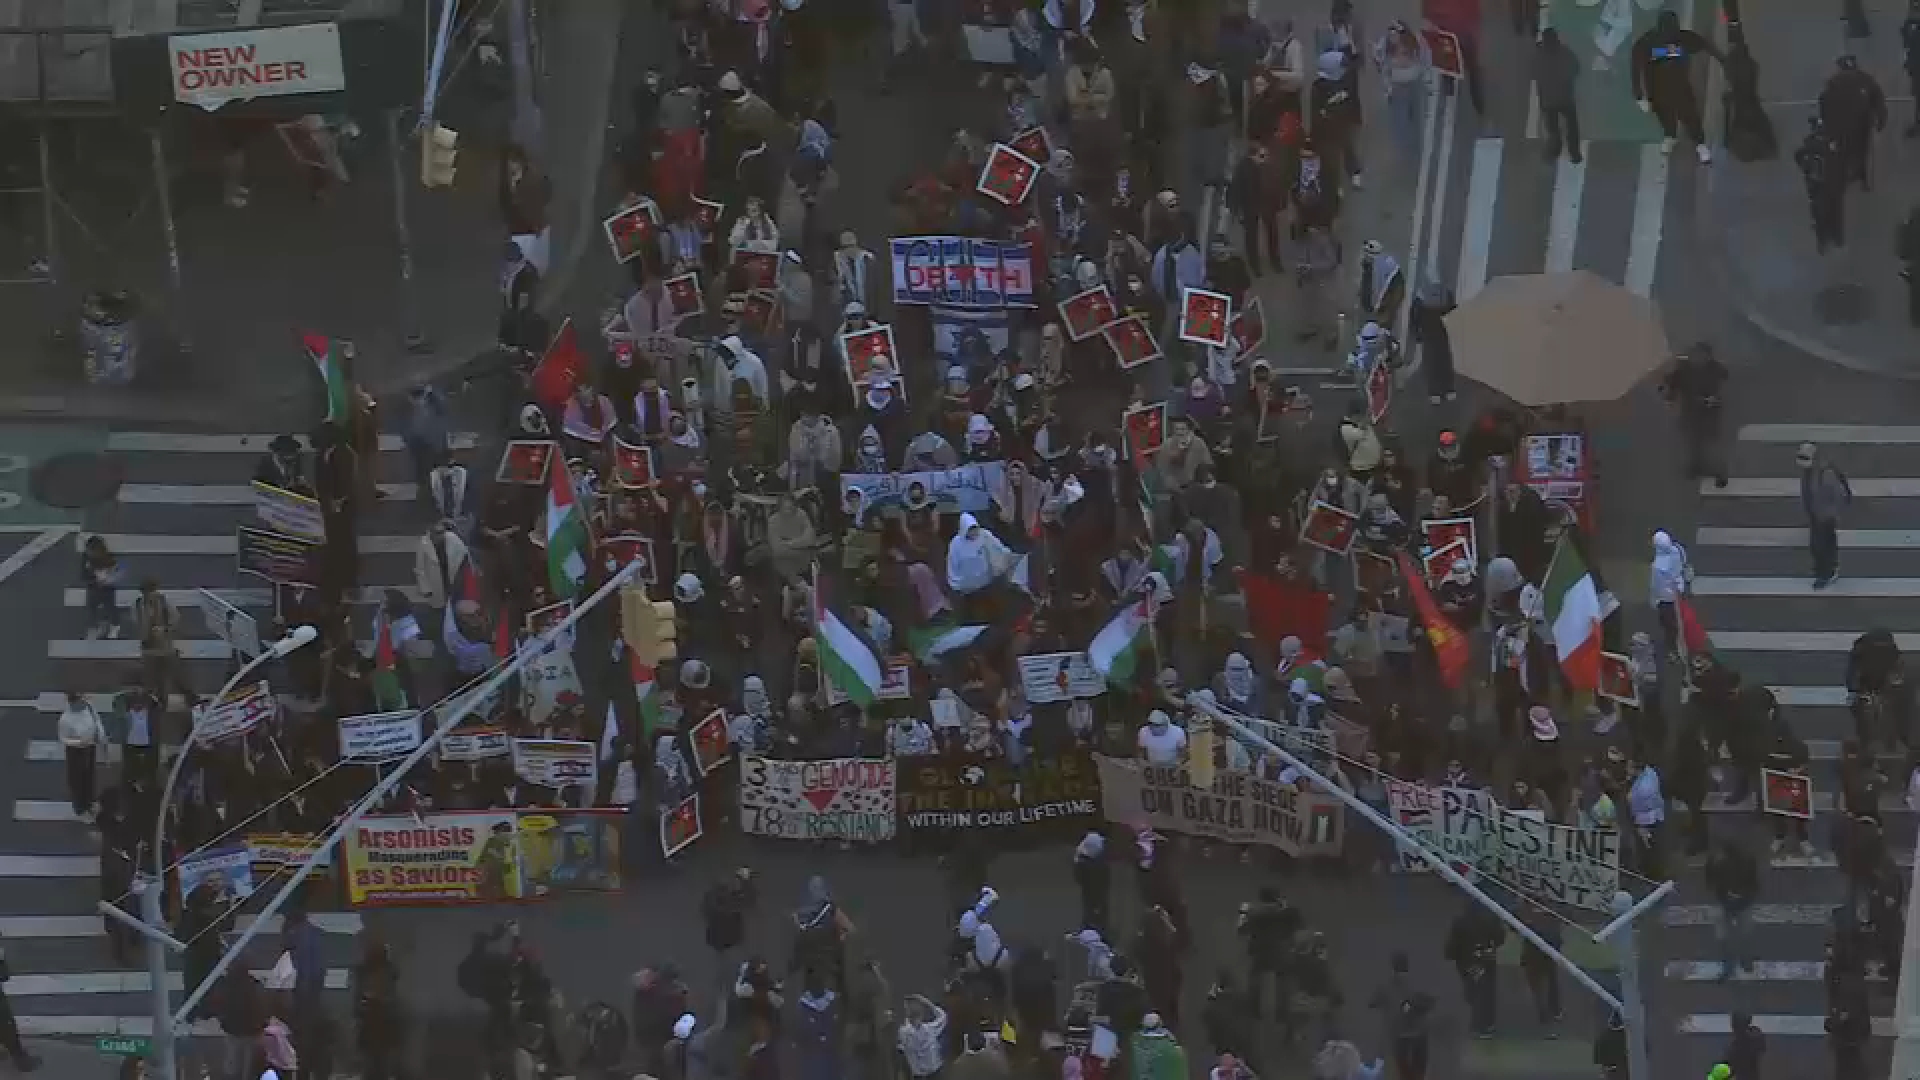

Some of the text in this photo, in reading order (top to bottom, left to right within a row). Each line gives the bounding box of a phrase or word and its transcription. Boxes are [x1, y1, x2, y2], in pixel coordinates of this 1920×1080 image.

[178, 45, 257, 69] NEW
[180, 62, 307, 90] OWNER
[747, 756, 767, 786] 3
[802, 760, 894, 790] GENOCIDE
[744, 804, 784, 835] 78
[908, 799, 1097, 829] WITHIN OUR LIFETIME
[1142, 787, 1174, 817] ON
[1184, 792, 1245, 830] GAZA
[1253, 802, 1304, 844] NOW
[1391, 783, 1618, 866] FREE PALESTINE
[358, 826, 475, 849] Arsonists
[355, 864, 487, 886] as Saviors
